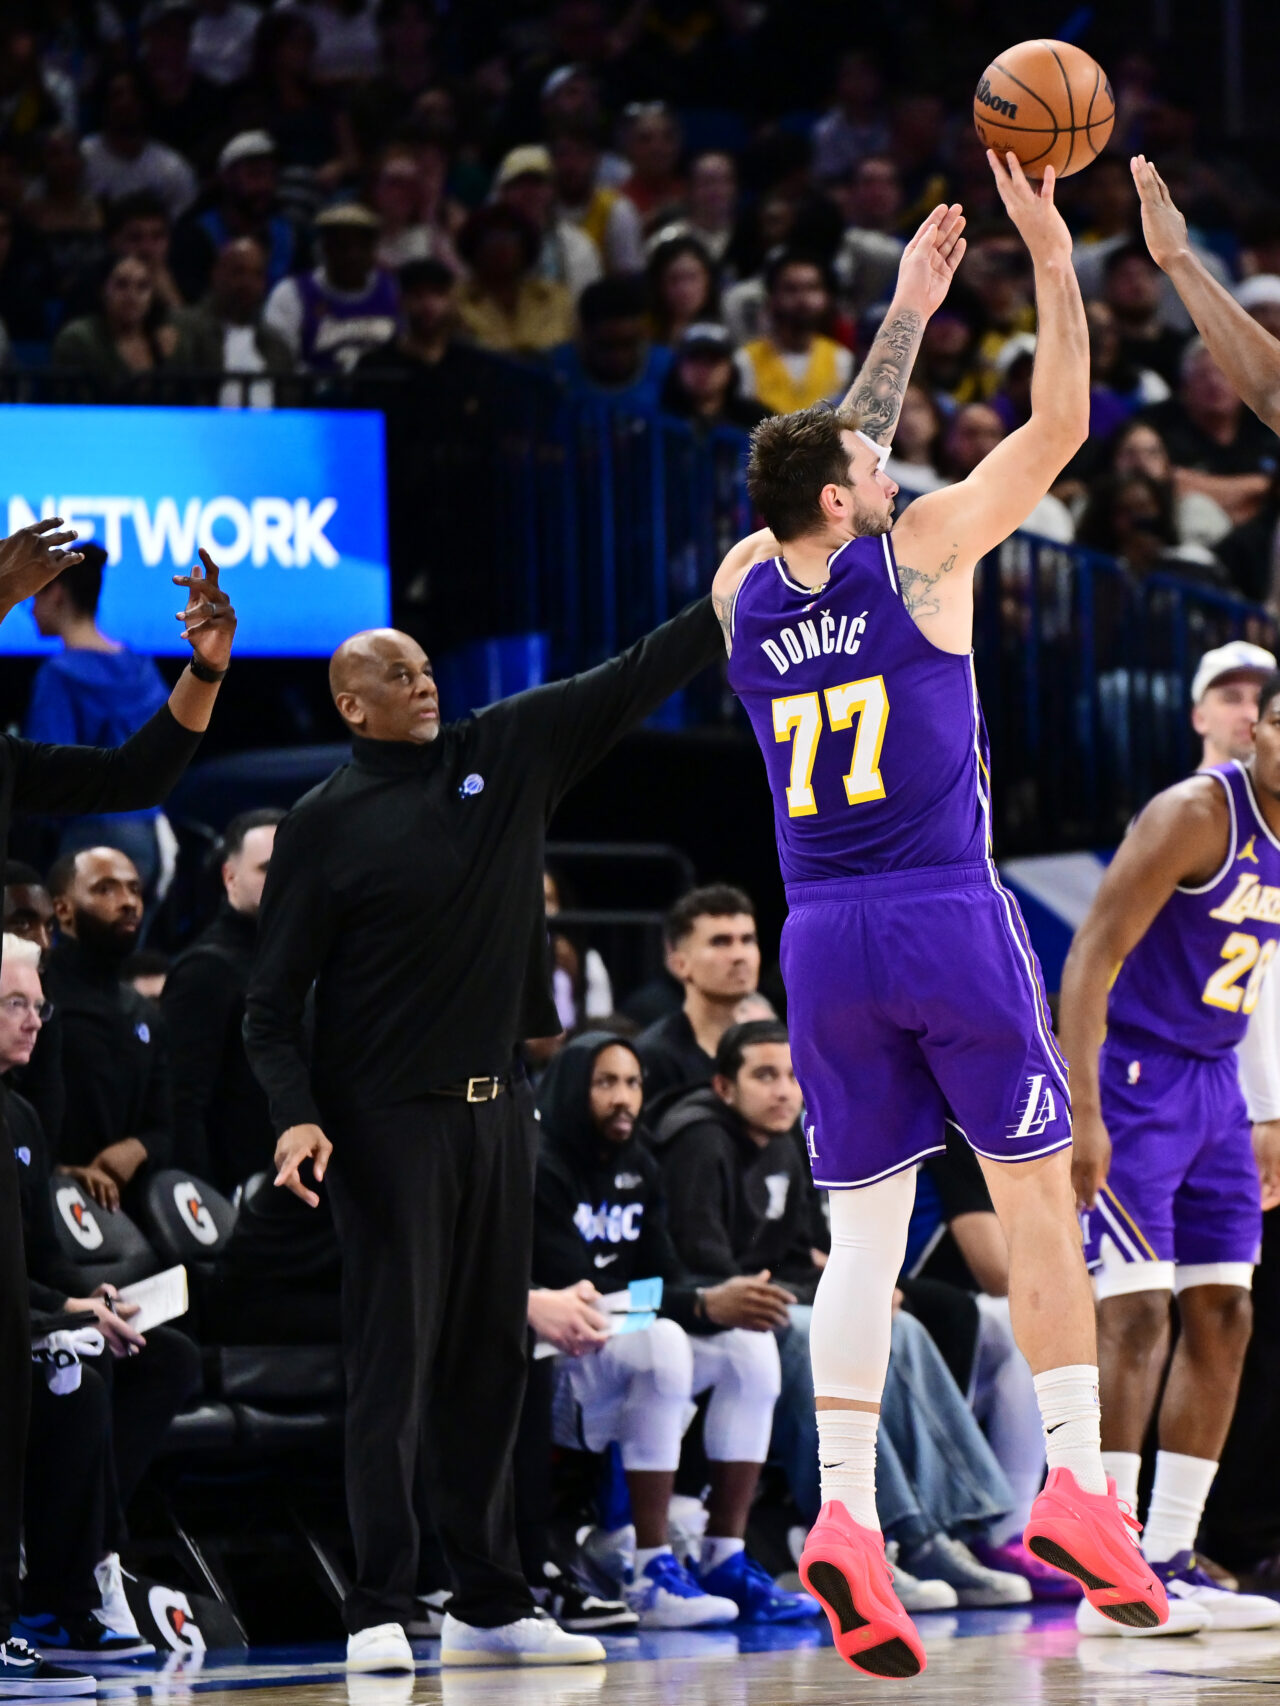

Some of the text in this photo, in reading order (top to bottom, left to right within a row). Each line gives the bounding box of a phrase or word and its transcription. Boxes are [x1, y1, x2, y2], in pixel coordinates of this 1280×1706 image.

[976, 78, 1018, 120] ilson
[8, 495, 340, 568] NETWORK
[761, 609, 869, 675] DONČIĆ
[771, 675, 891, 818] 77
[1005, 1074, 1057, 1139] LA
[56, 1186, 104, 1250] G
[173, 1181, 219, 1246] G
